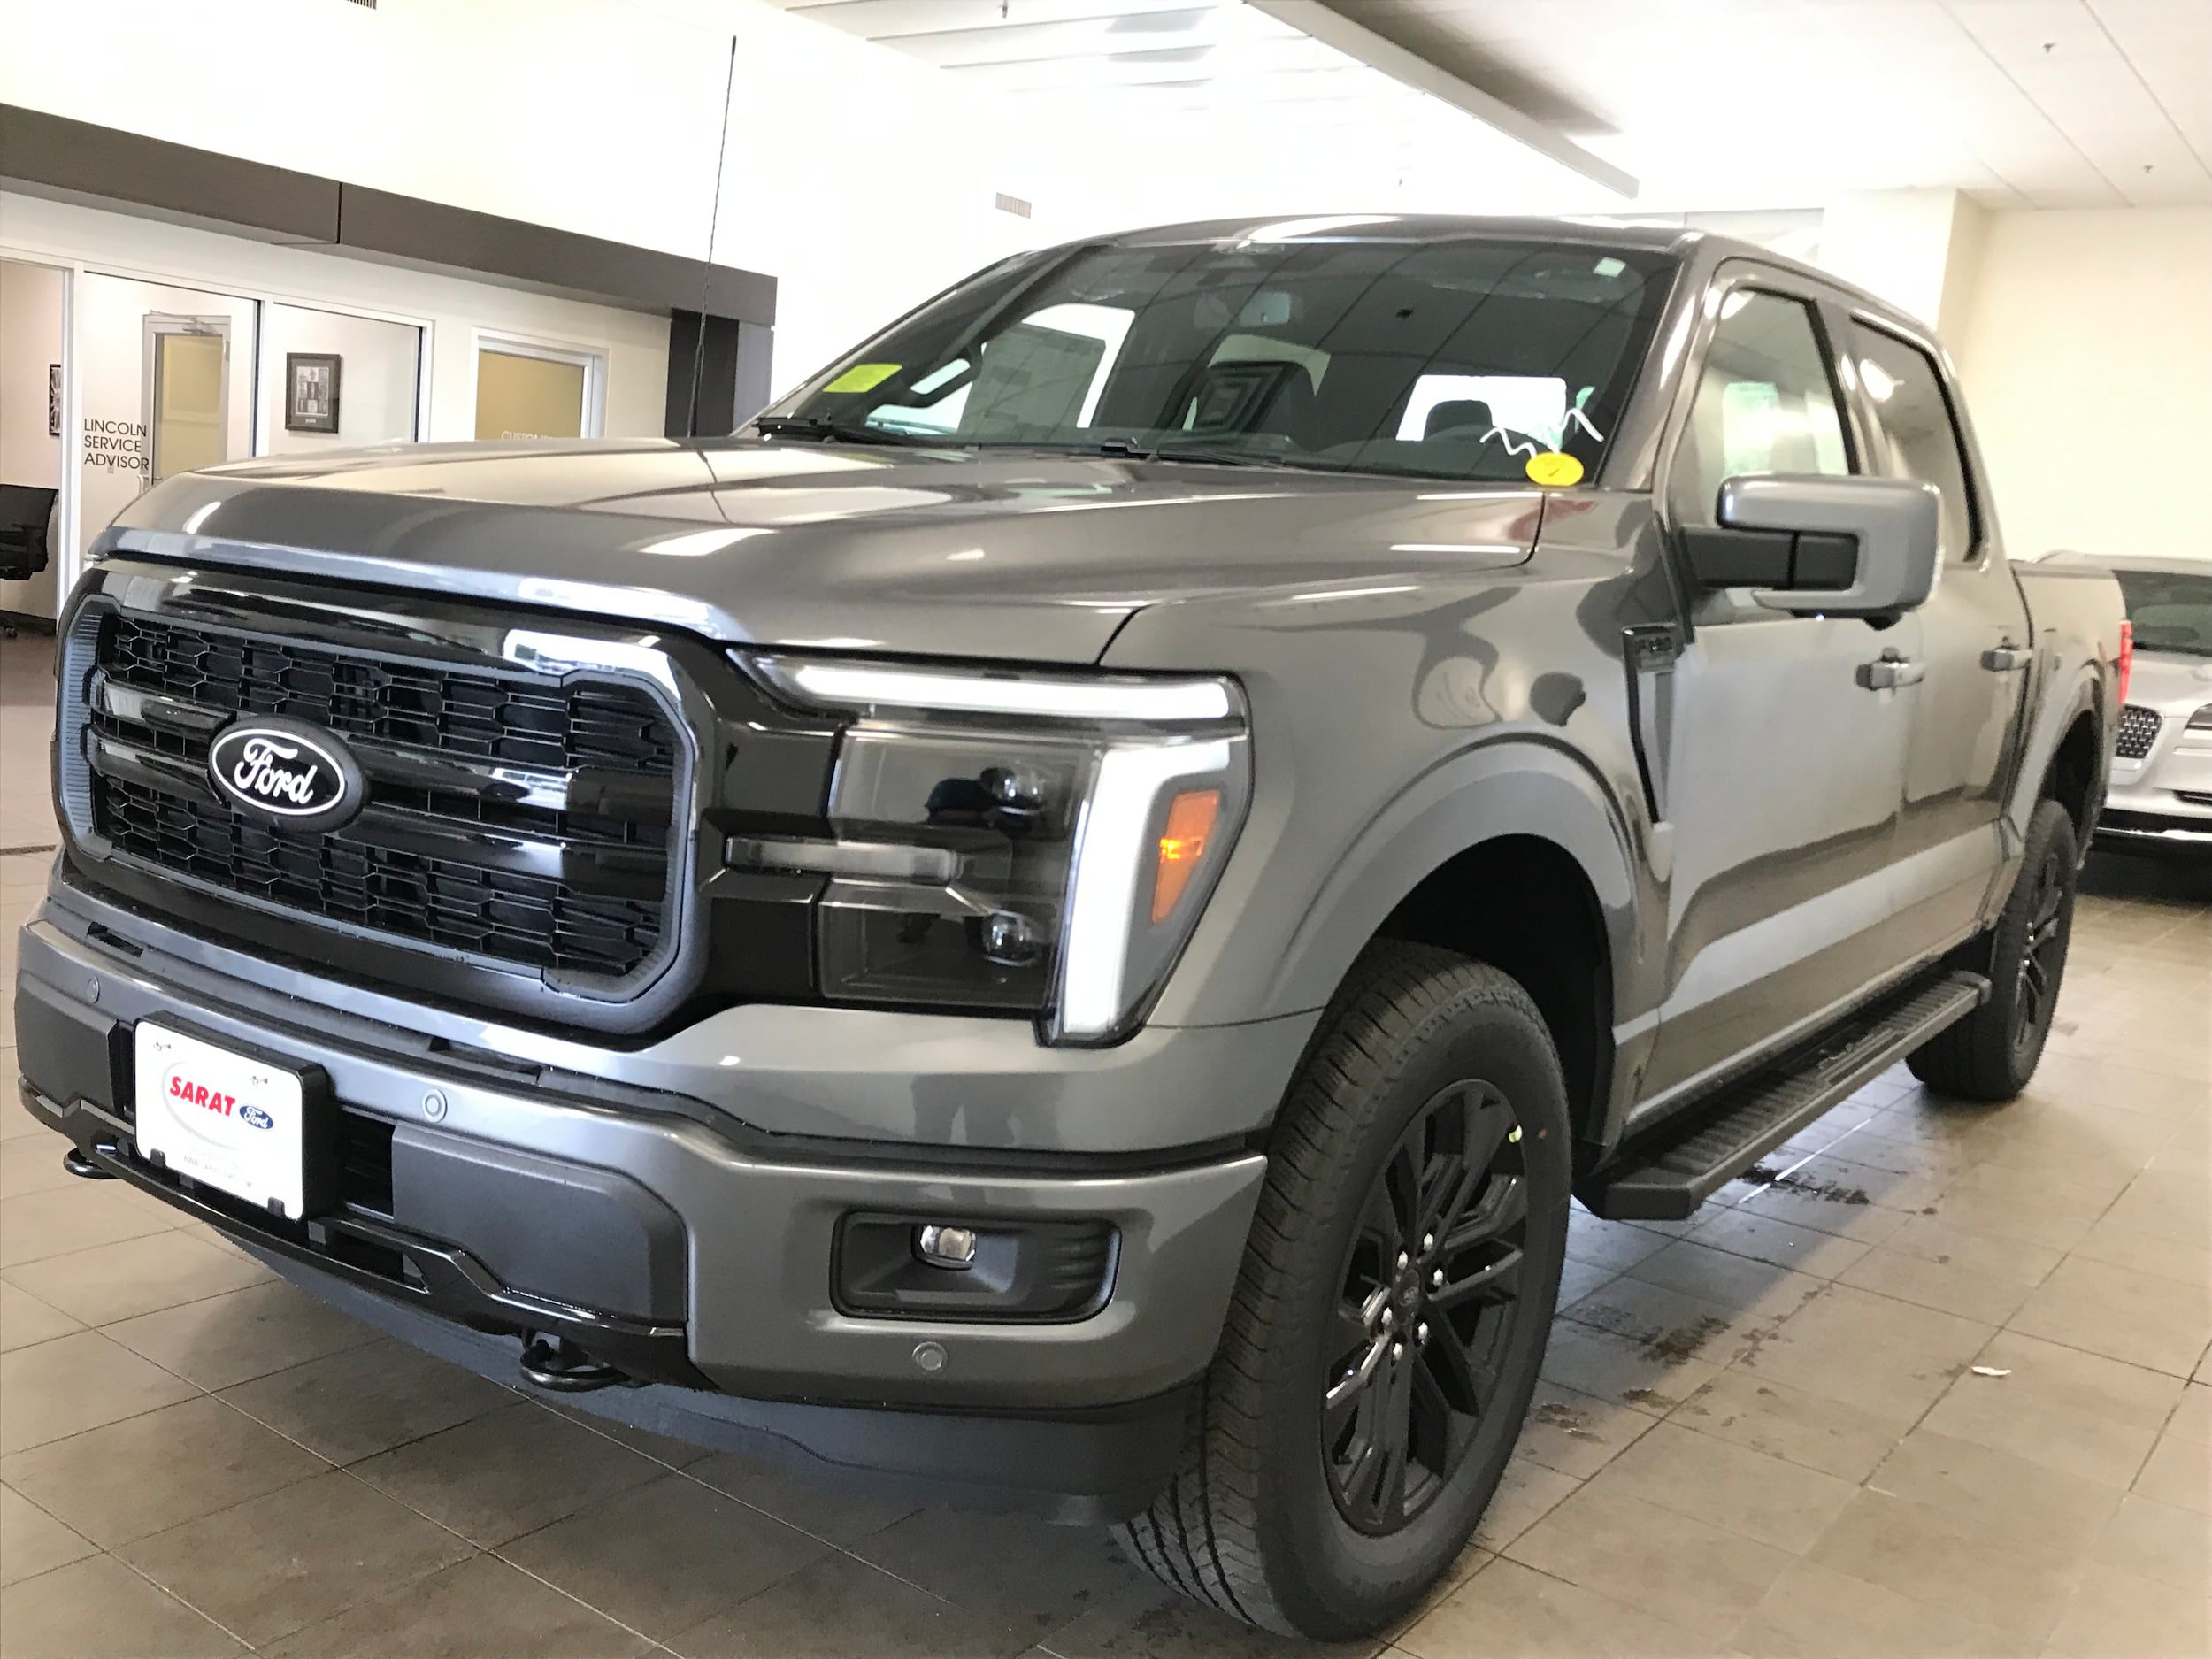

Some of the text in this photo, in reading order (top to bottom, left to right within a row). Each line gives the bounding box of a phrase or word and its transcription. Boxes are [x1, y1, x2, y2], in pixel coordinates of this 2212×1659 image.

[84, 418, 147, 437] LINCOLN
[501, 430, 554, 440] CUSTOM
[84, 434, 142, 453] SERVICE
[84, 452, 150, 471] ADVISOR
[234, 737, 319, 805] Ford
[169, 1075, 269, 1129] SARAT Ford
